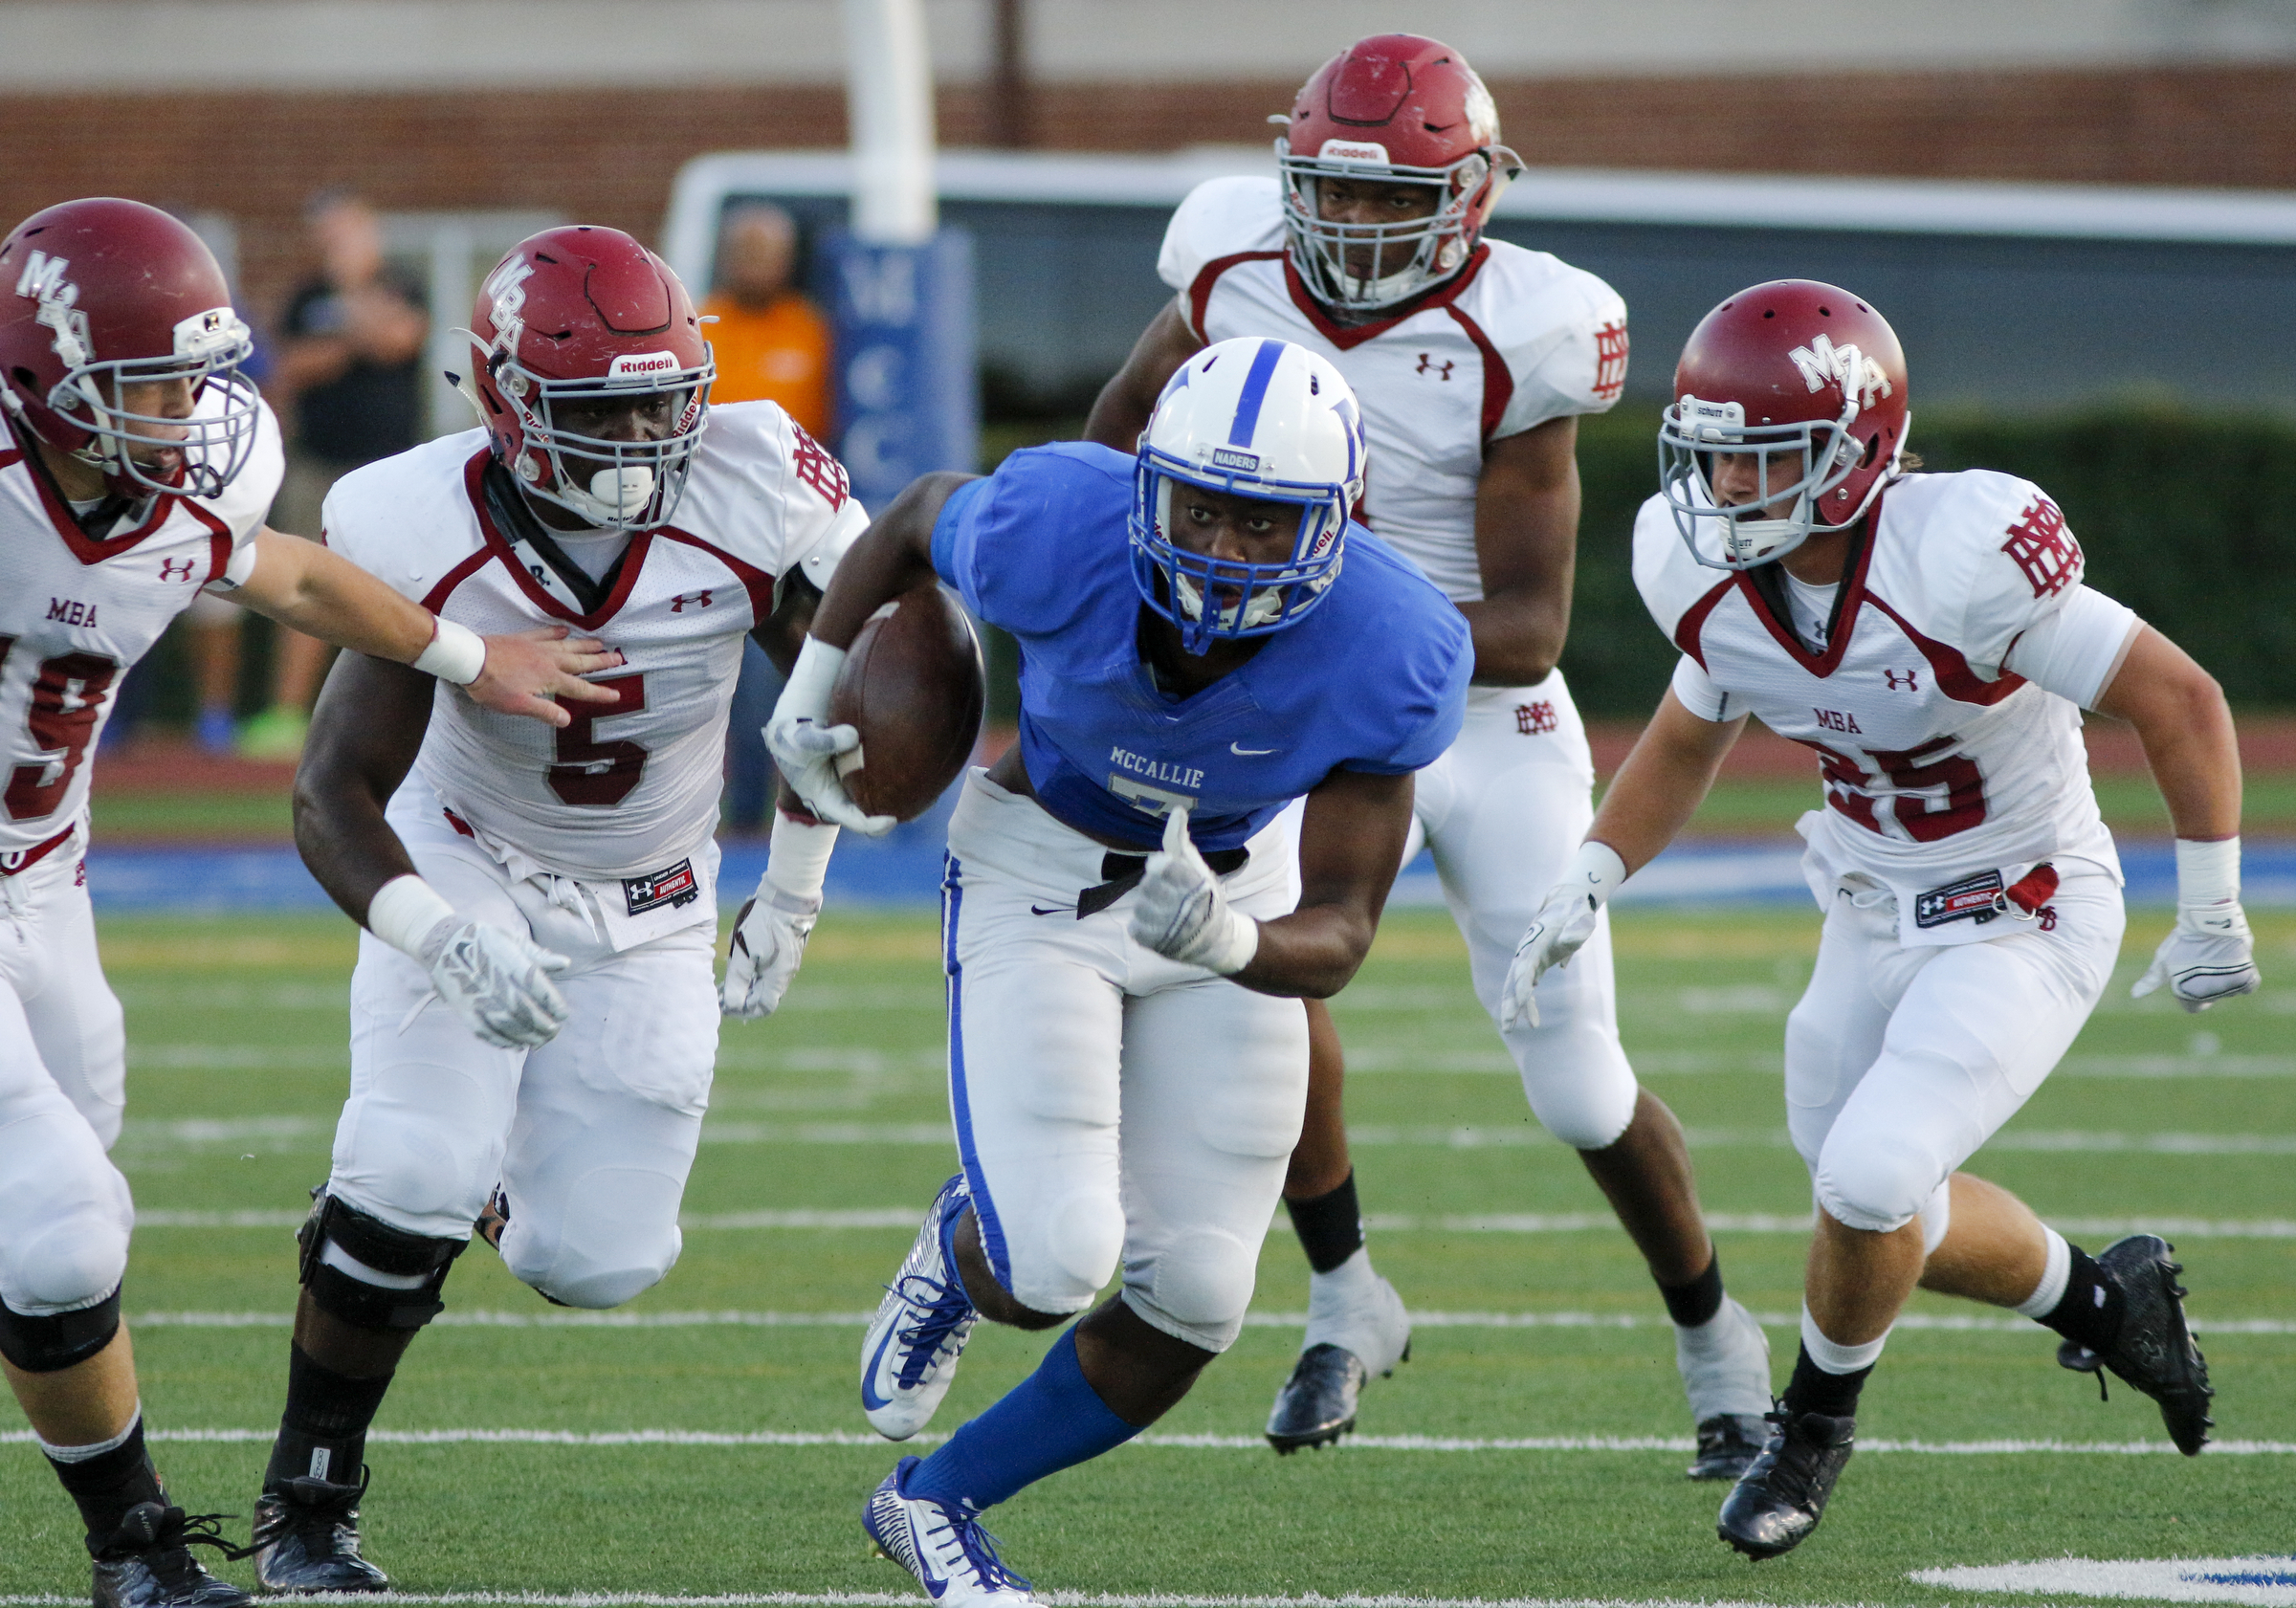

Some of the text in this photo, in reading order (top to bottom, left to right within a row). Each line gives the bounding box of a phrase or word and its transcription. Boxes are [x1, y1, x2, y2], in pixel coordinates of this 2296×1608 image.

[620, 358, 673, 373] Riddell
[1697, 405, 1723, 418] schutt
[1215, 451, 1258, 471] NADERS
[46, 597, 98, 628] MBA
[1813, 708, 1863, 735] MBA
[543, 672, 652, 807] 5
[1110, 746, 1204, 789] MCCALLIE
[659, 874, 687, 896] AUTHENTIC
[1953, 892, 1993, 908] AUTHENTIC
